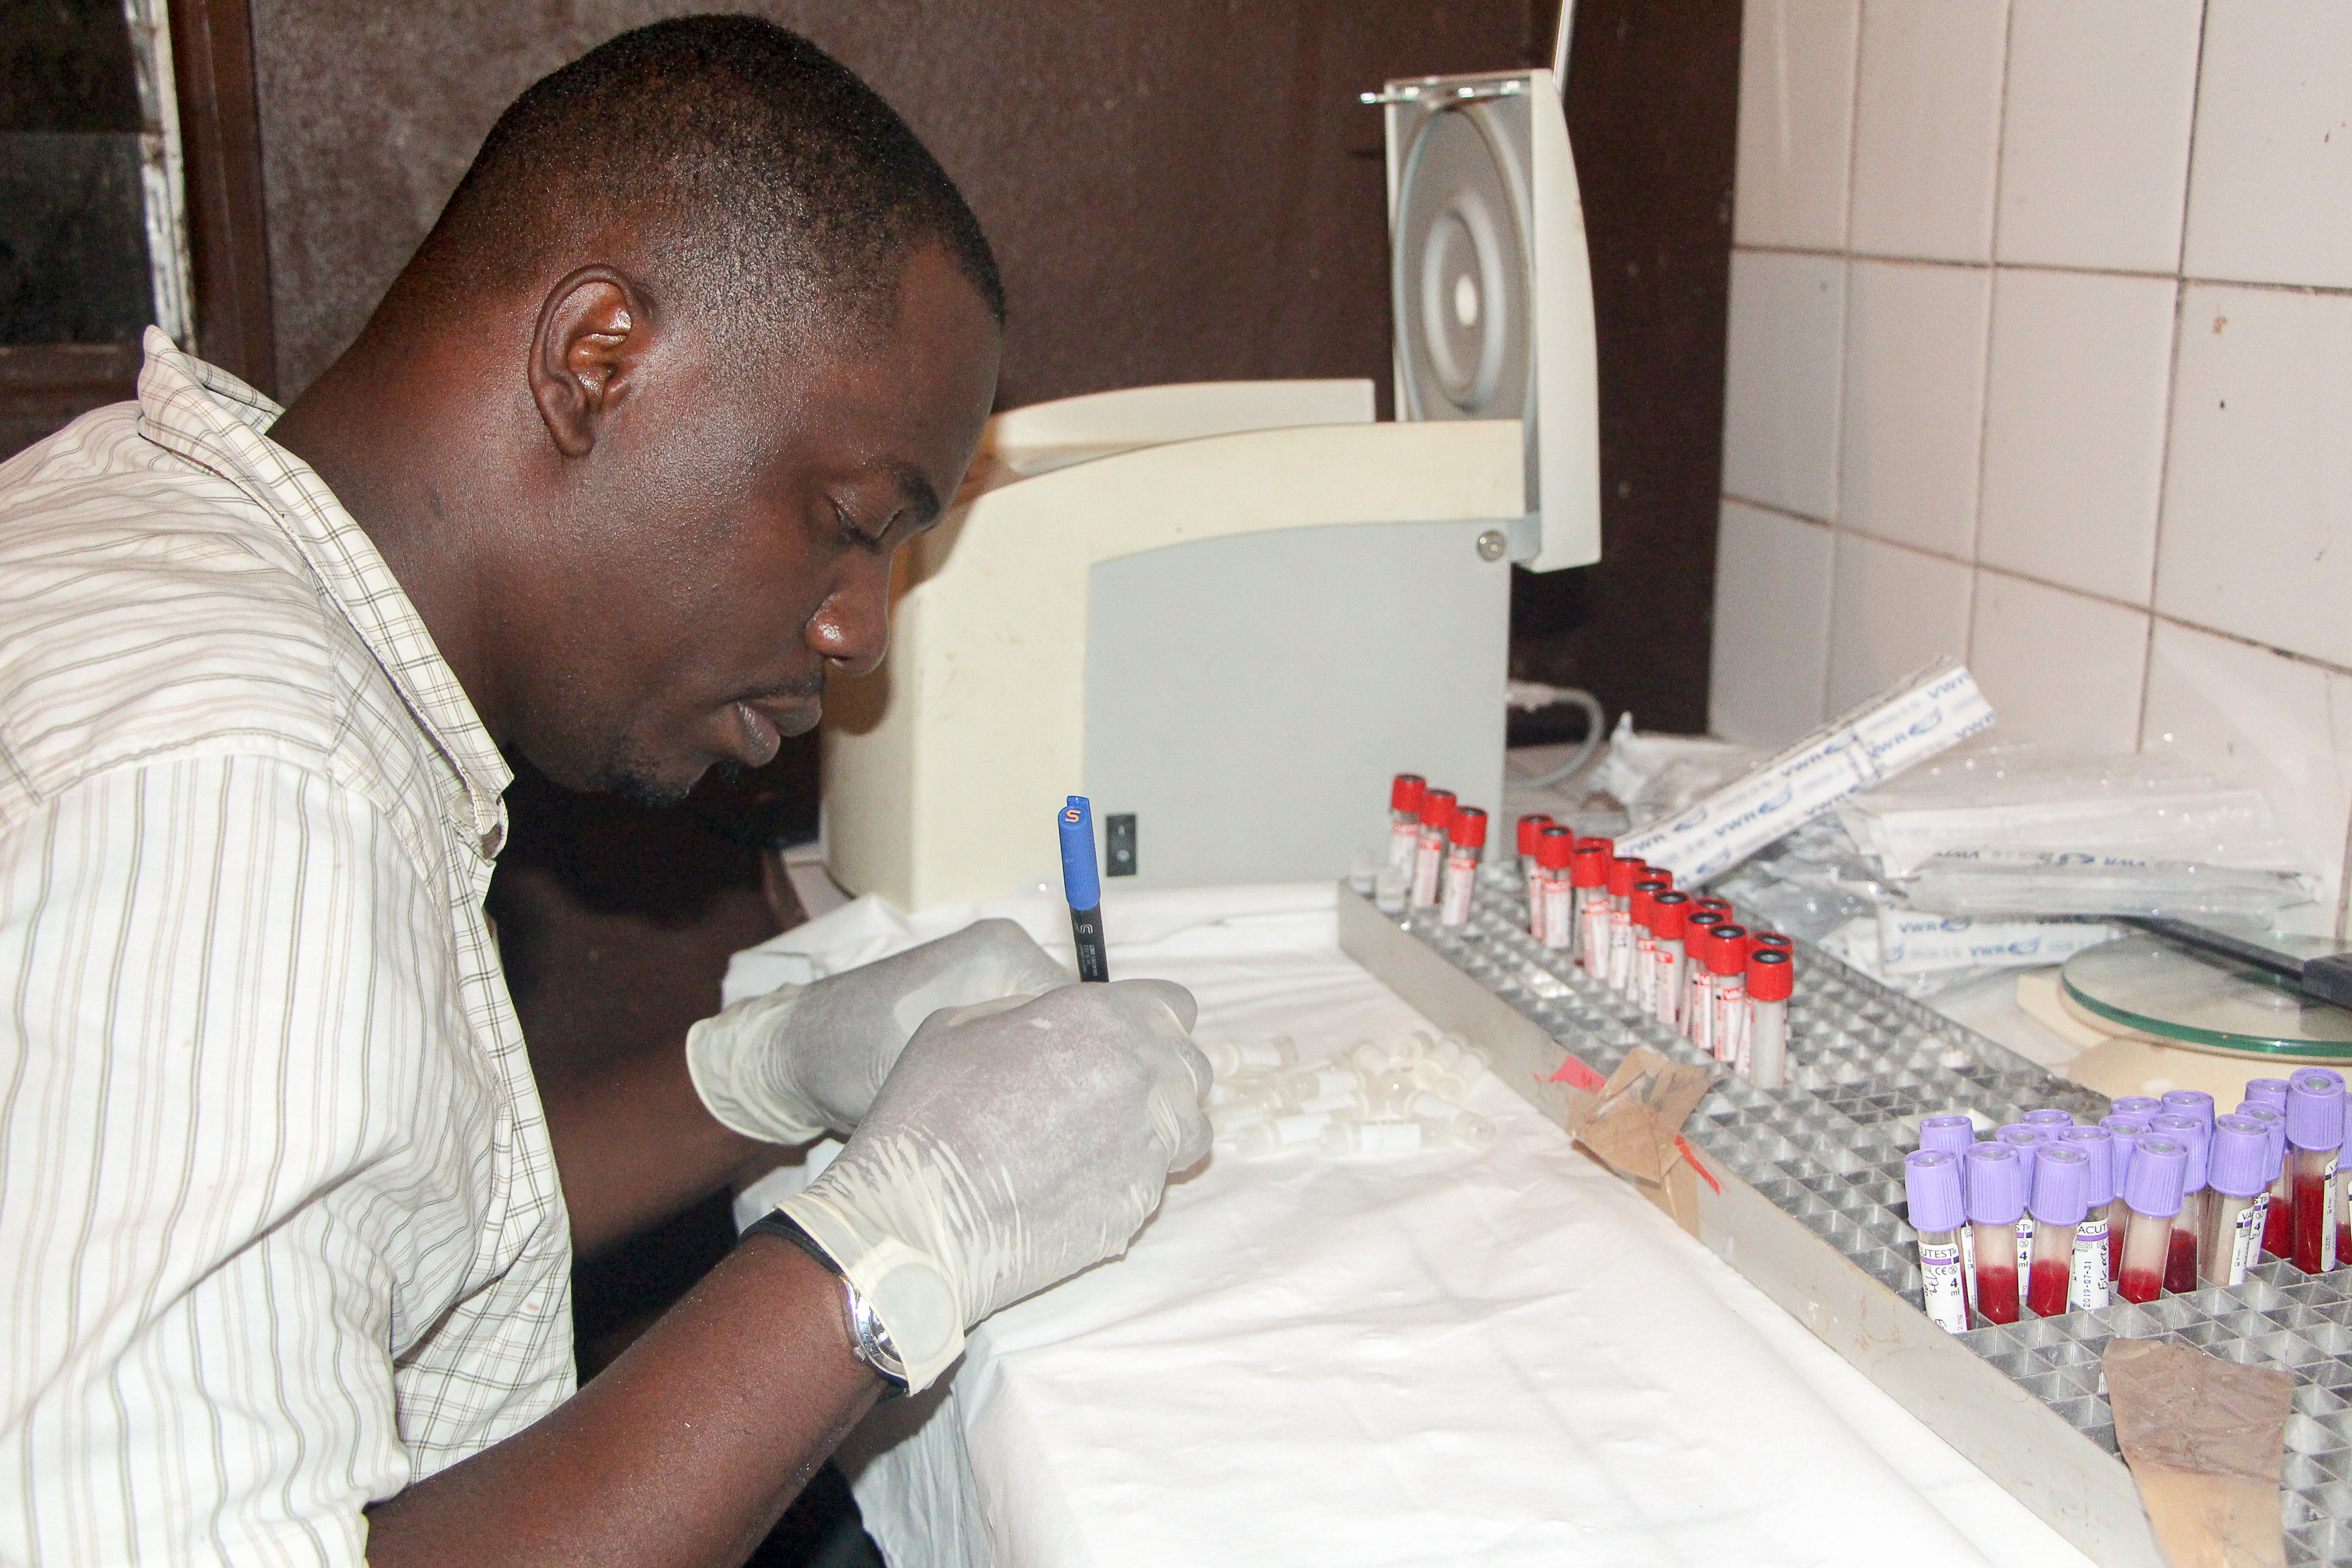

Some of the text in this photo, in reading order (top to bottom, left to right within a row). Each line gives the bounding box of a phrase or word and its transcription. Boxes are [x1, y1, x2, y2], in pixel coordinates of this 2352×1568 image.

[1064, 809, 1081, 823] S
[1715, 810, 1756, 836] VWR
[2078, 1223, 2109, 1234] ACUT
[2019, 1251, 2027, 1260] 4
[1950, 1277, 1958, 1287] 4
[2083, 1261, 2091, 1307] 2019-07-31
[1951, 1288, 1960, 1296] ml
